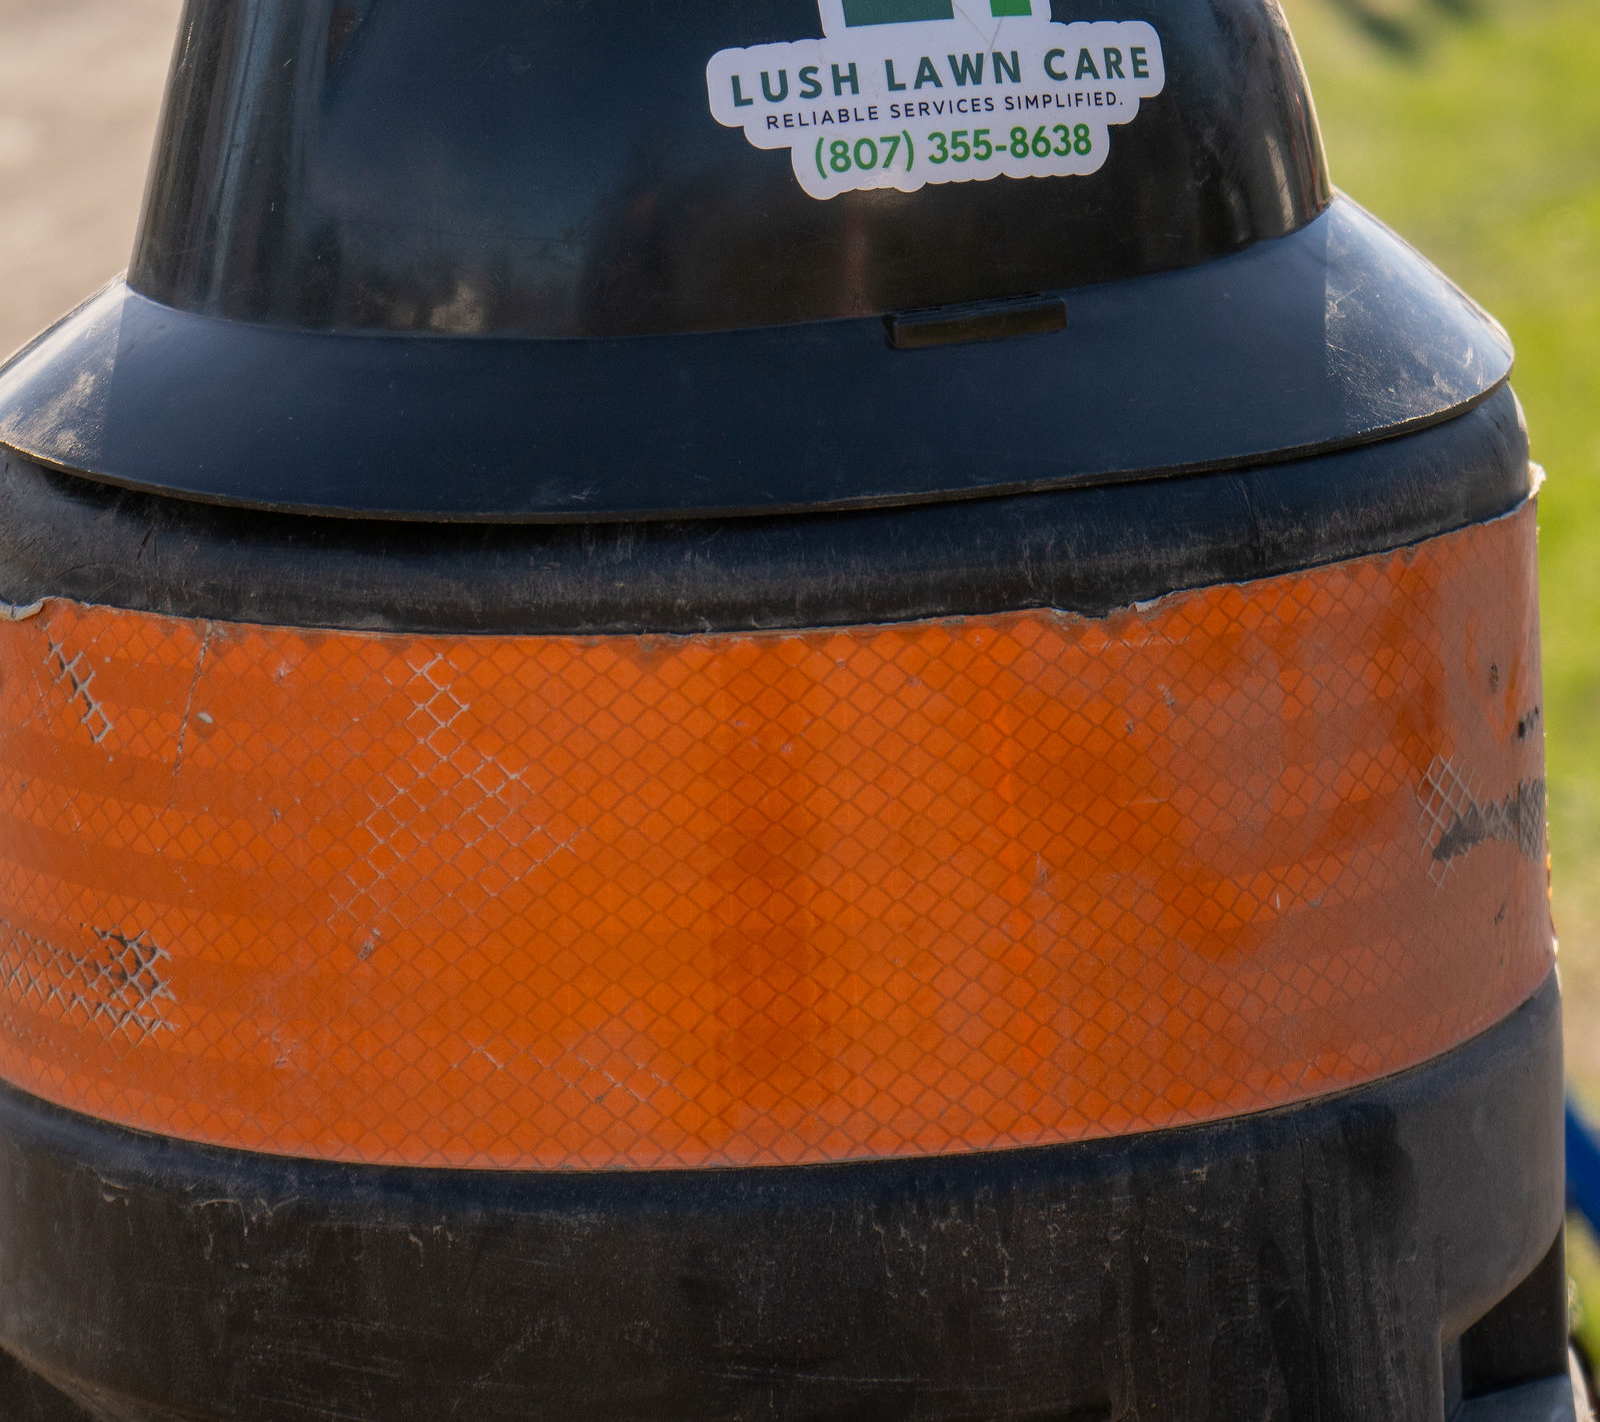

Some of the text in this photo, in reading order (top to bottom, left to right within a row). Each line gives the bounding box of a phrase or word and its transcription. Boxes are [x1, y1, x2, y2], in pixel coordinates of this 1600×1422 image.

[730, 46, 1150, 108] LUSH LAWN CARE
[766, 91, 1124, 130] RELIABLE SERVICES SIMPLIFIED.
[814, 123, 1093, 180] (807) 355-8638
